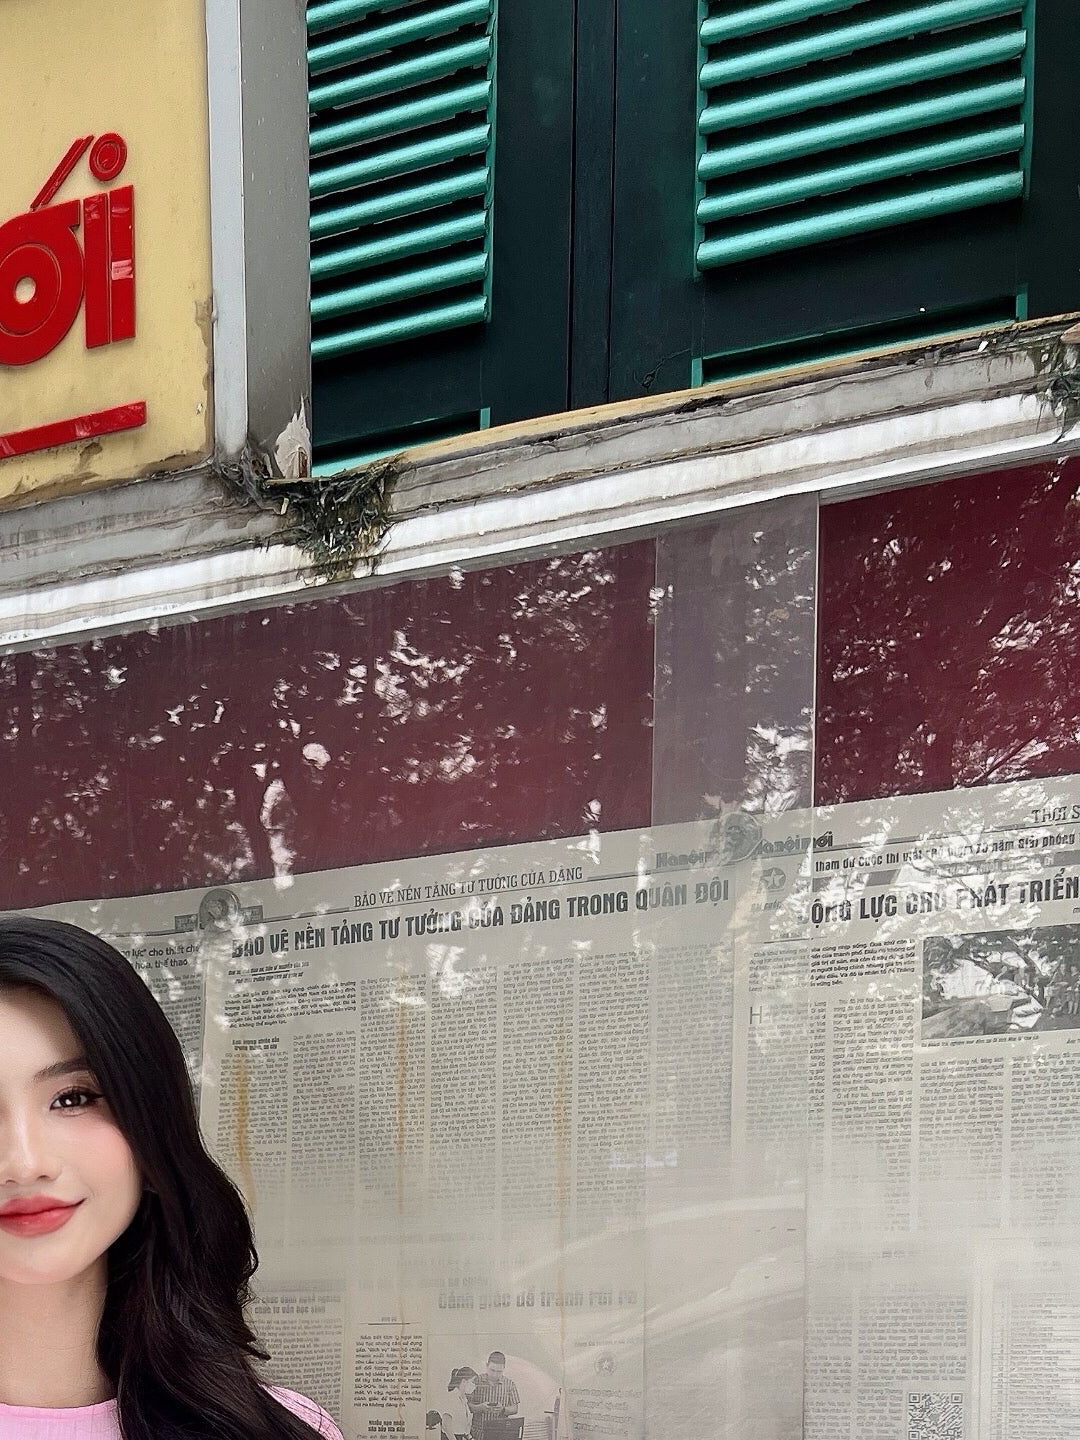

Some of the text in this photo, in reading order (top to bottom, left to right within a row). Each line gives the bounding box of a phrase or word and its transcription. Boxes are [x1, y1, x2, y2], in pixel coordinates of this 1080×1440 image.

[521, 869, 545, 887] CỦA
[295, 922, 326, 950] NỀN
[331, 918, 373, 946] TẢNG
[379, 916, 401, 940] TƯ
[510, 896, 560, 925] ĐẢNG
[567, 891, 629, 918] TRONG
[635, 881, 688, 911] QUÂN
[695, 876, 729, 907] ĐỘI
[860, 894, 898, 923] LỰC
